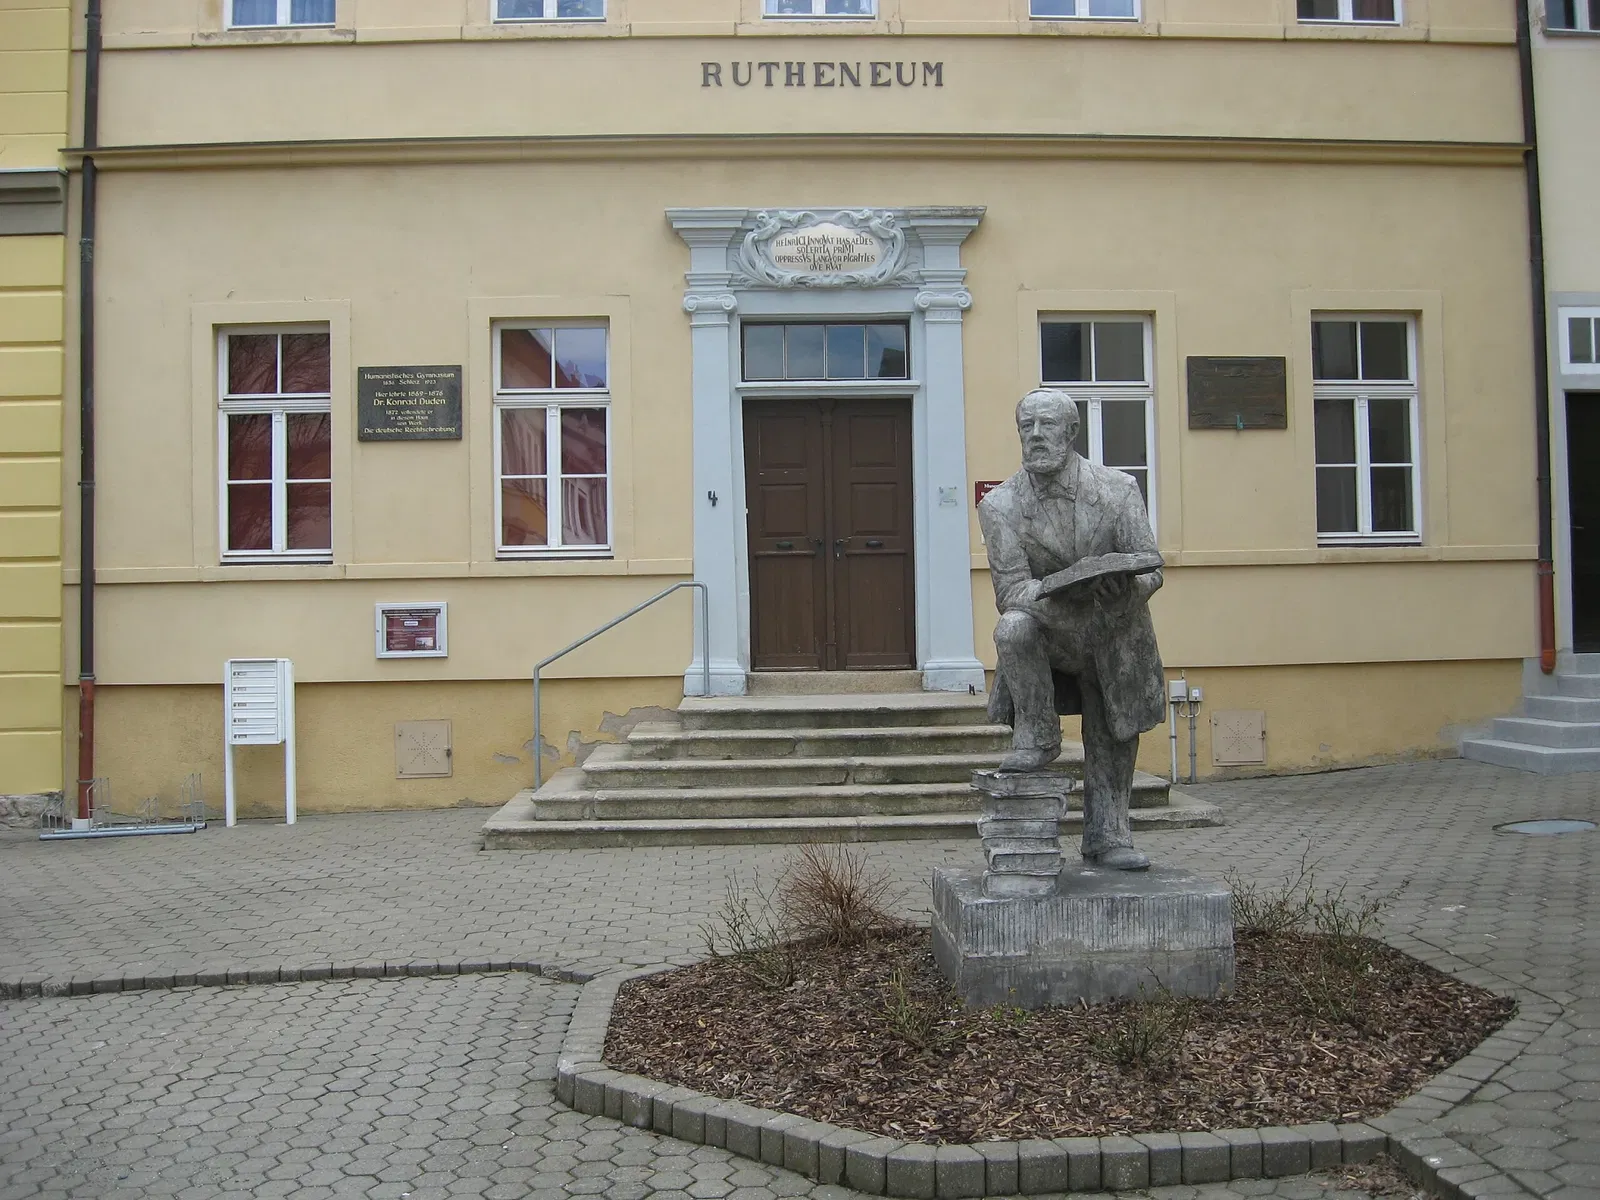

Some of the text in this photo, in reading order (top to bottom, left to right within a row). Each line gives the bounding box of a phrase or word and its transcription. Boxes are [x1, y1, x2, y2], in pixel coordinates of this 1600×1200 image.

[701, 61, 943, 87] RUTHENEUM
[416, 372, 455, 380] Gymnasium
[373, 397, 446, 406] Dr. Konrad Duden
[375, 426, 403, 434] deutsche
[404, 425, 456, 433] Rechtschreibung
[707, 490, 718, 507] 4
